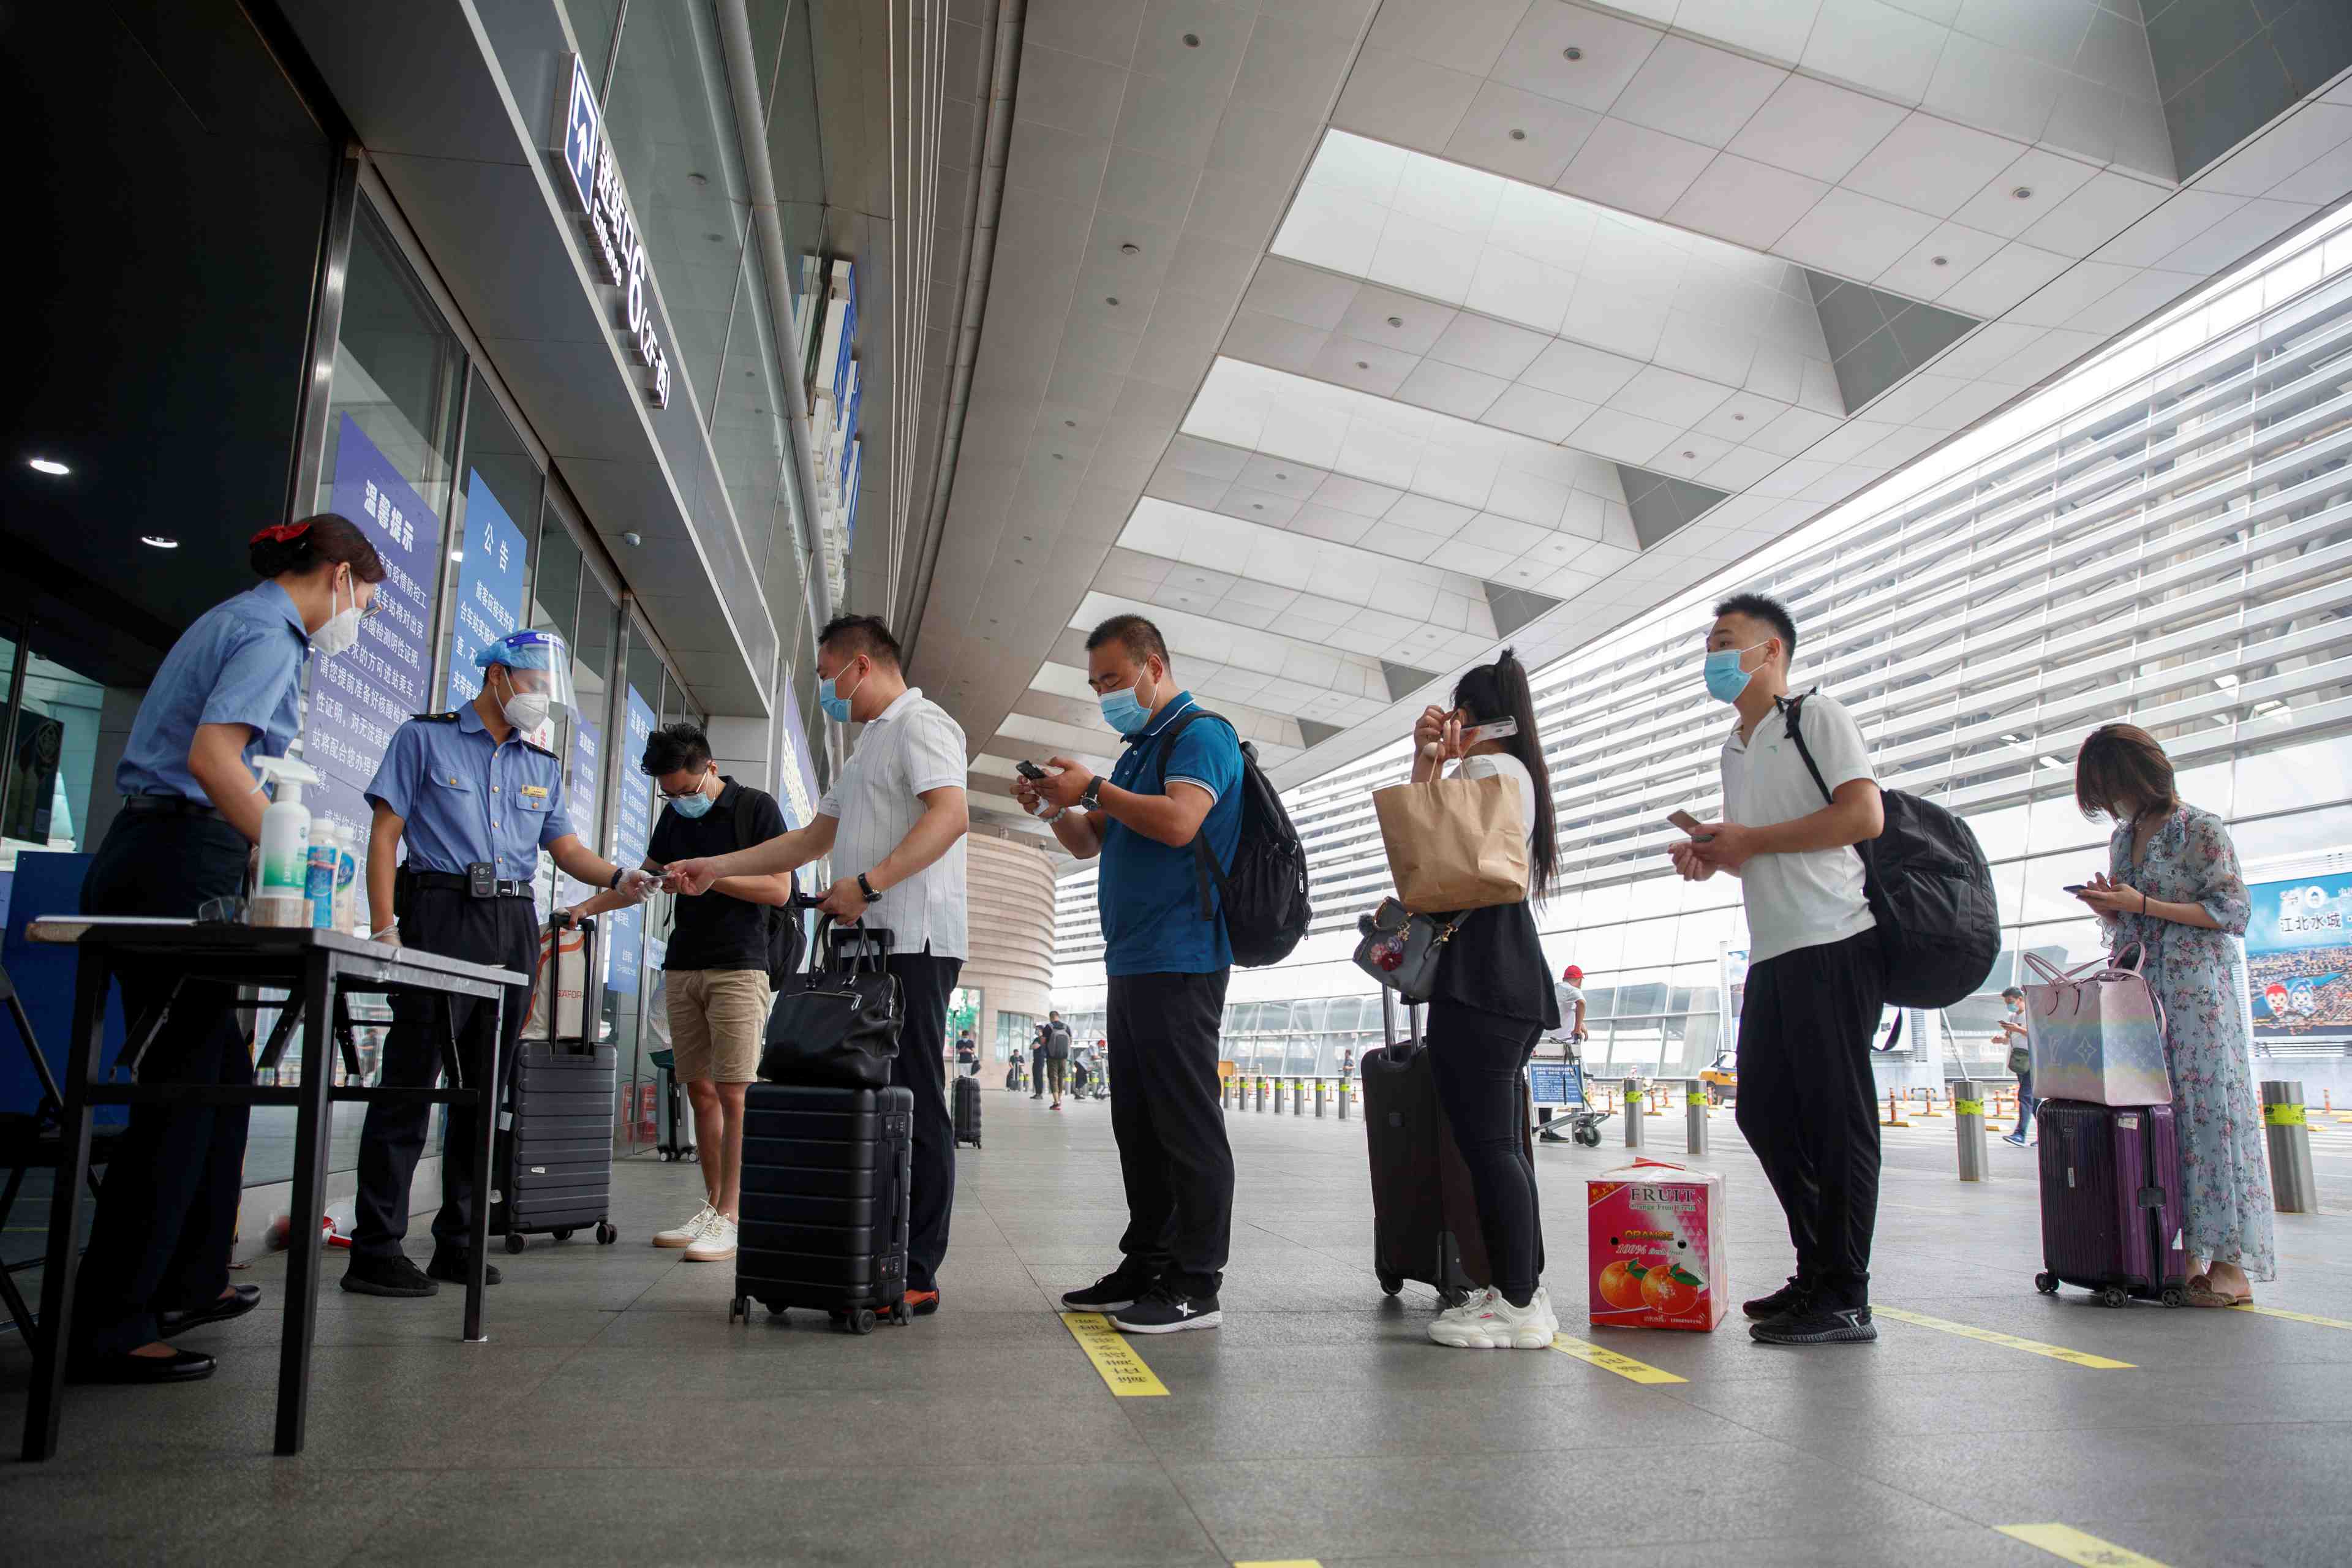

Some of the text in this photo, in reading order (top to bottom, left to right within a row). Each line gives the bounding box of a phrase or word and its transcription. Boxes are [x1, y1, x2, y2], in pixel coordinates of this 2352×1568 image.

[592, 198, 622, 287] Entrance
[364, 479, 414, 553] 温馨提示
[484, 522, 509, 573] 公告
[358, 615, 420, 671] 核酸检测阴性证明，
[461, 600, 499, 646] 合车站实施的
[320, 654, 415, 726] 请您提前准备好核酸检测
[1630, 1188, 1696, 1202] FRUIT
[1615, 1244, 1647, 1254] 100%
[1625, 1229, 1675, 1241] ORANGE
